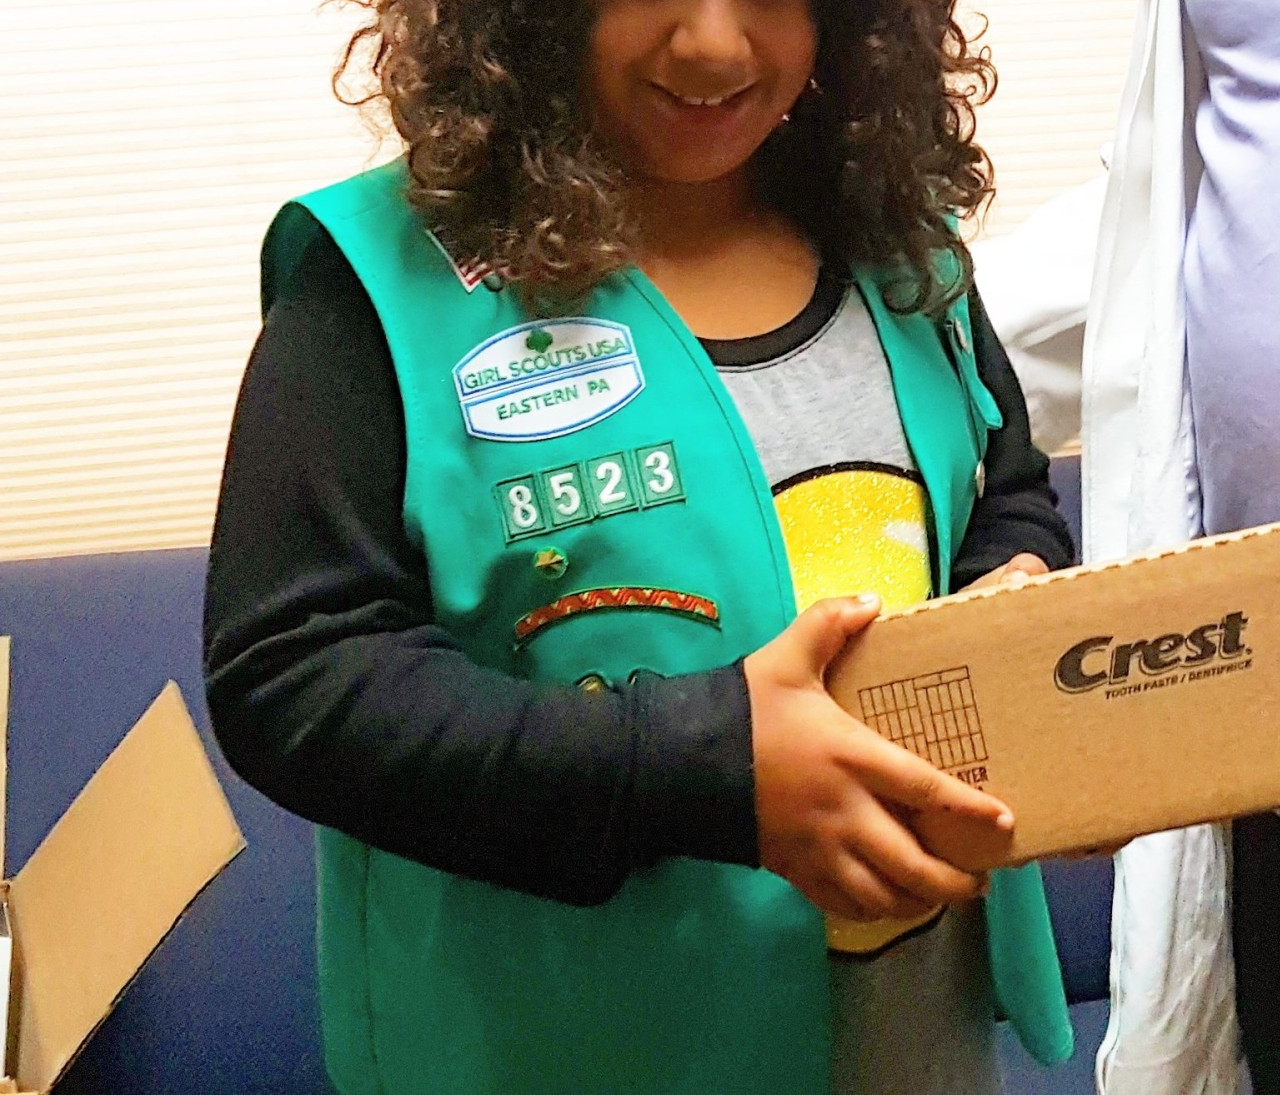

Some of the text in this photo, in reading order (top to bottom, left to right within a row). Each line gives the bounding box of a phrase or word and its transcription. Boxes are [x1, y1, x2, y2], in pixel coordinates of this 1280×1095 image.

[465, 337, 626, 389] GIRL SCOUTS USA
[496, 378, 611, 420] EASTERN PA
[508, 451, 674, 528] 8523
[1054, 611, 1249, 694] Crest
[1105, 684, 1144, 700] TOOTH
[1144, 675, 1178, 691] PASTE
[1188, 658, 1253, 681] DENTIFRICE
[949, 766, 989, 785] AYER
